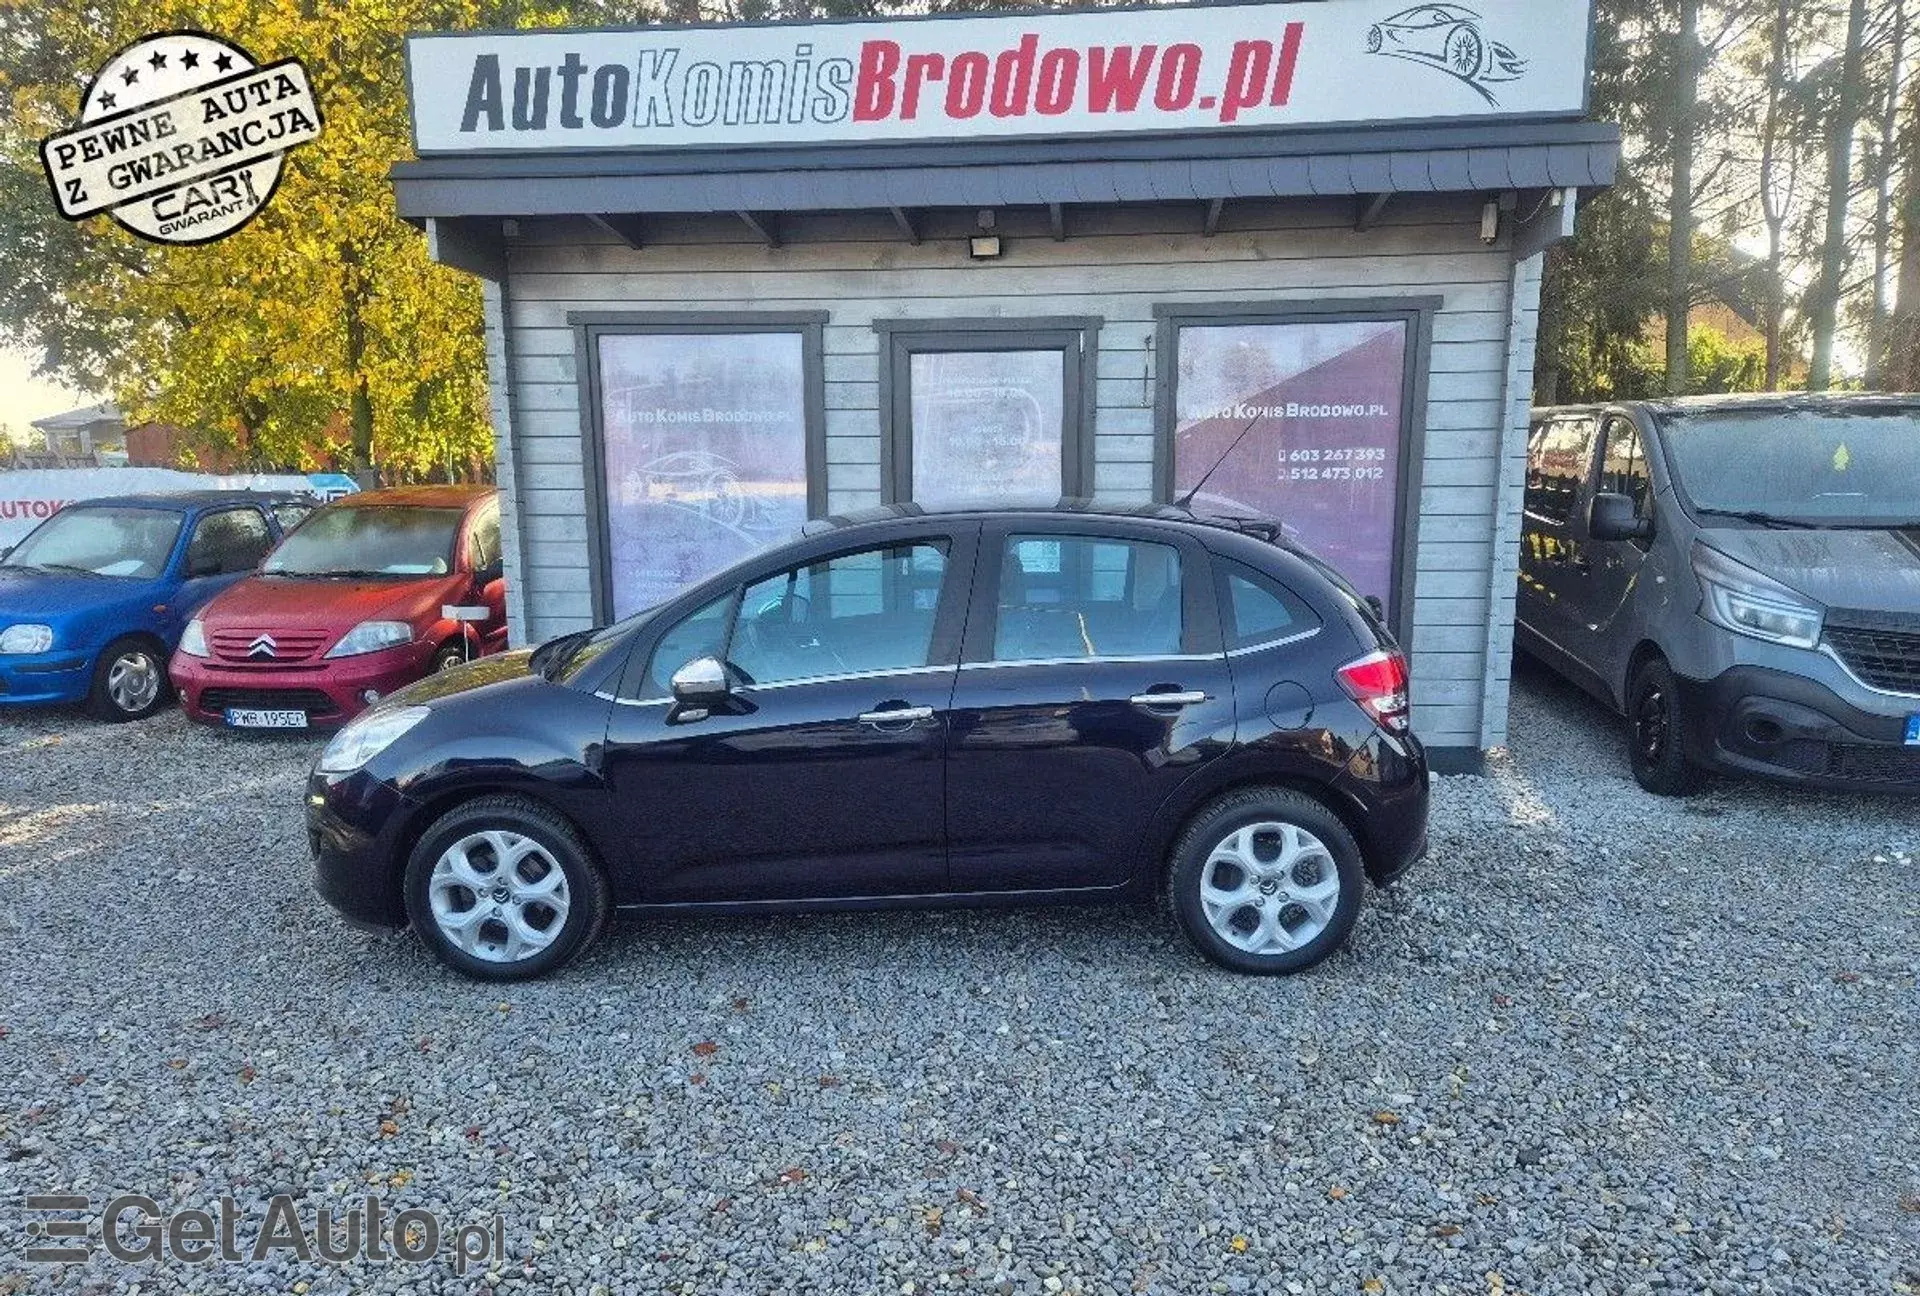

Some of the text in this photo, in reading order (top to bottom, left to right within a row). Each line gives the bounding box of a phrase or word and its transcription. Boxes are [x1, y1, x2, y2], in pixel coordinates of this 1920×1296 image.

[460, 22, 1304, 131] AutoKomisBrodowo.pl
[1289, 448, 1386, 462] 603 267 393
[1290, 466, 1384, 480] 512 473 012
[0, 500, 64, 519] UTOK
